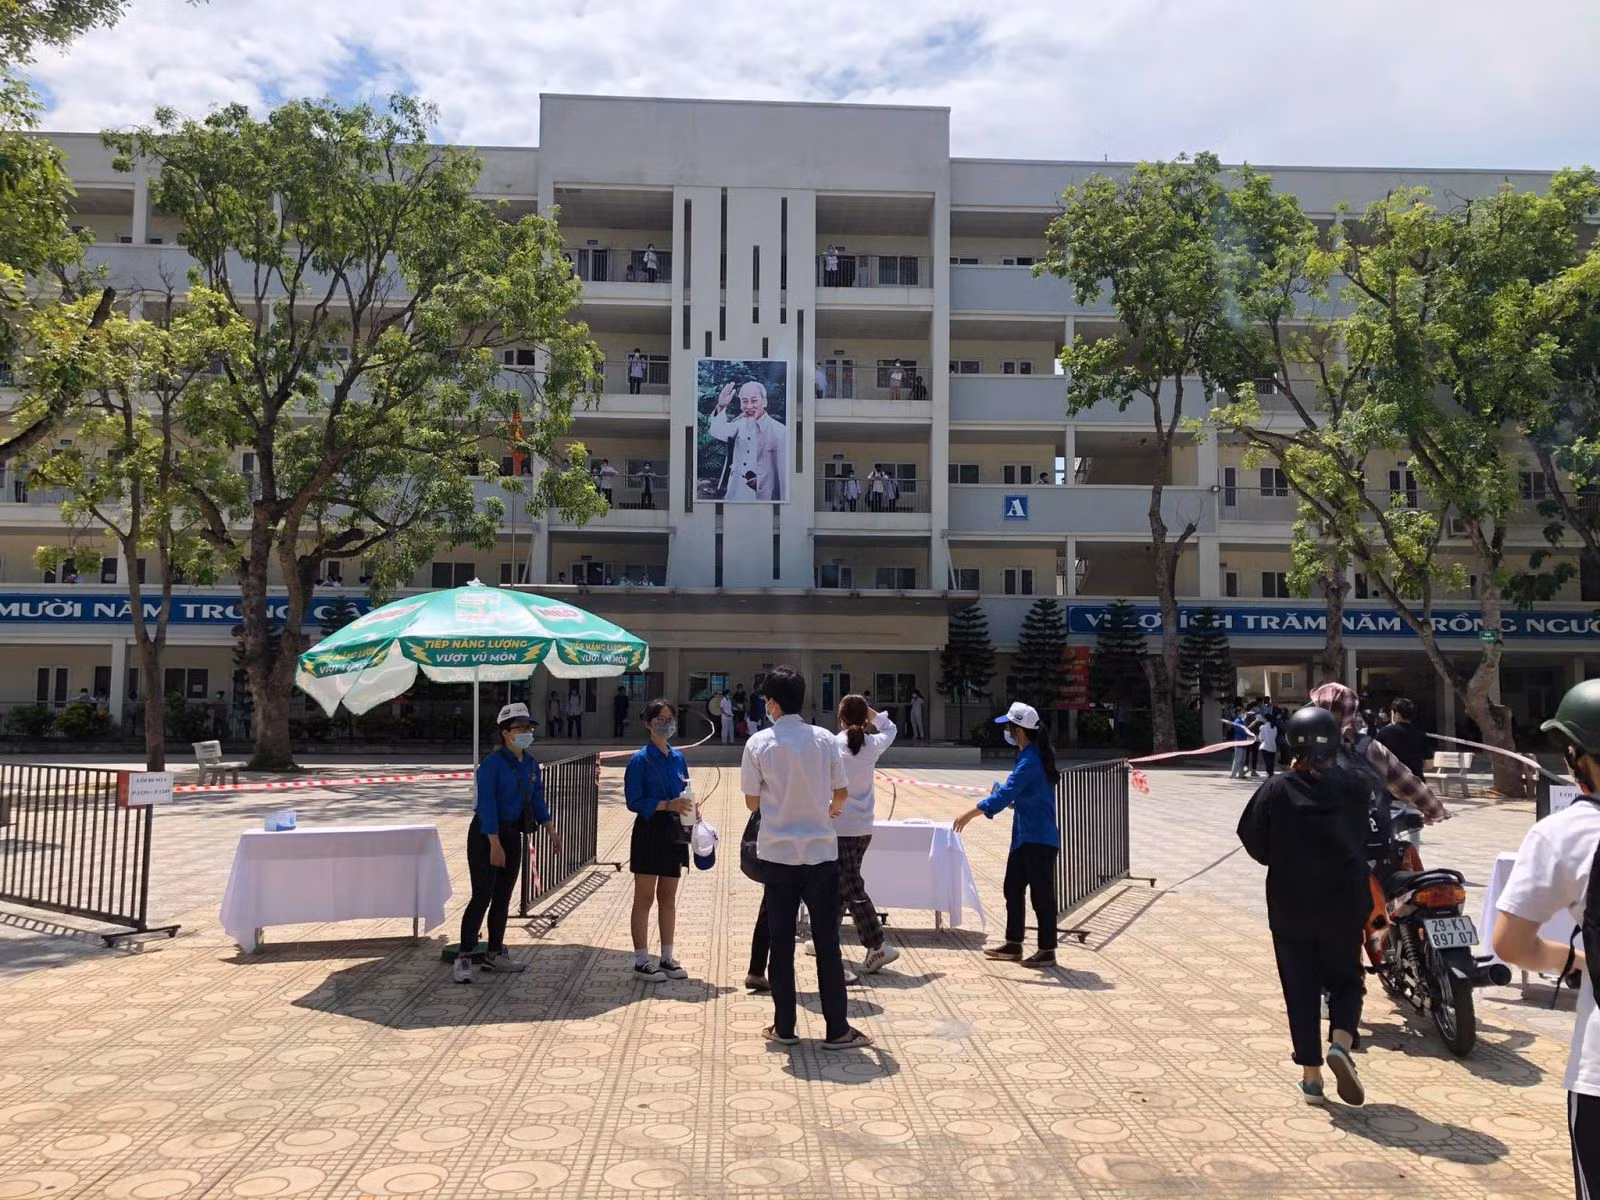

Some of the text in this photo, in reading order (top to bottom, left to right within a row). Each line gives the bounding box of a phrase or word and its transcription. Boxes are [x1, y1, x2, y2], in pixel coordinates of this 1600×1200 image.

[1006, 498, 1026, 517] A
[0, 598, 82, 618] MƯỜI
[181, 603, 290, 620] TRG
[1241, 612, 1327, 630] TRĂM
[1342, 613, 1401, 631] NĂM
[1417, 611, 1517, 632] RỒG
[424, 639, 450, 649] TIẾP
[488, 639, 528, 651] LƯỢNG
[435, 652, 468, 664] VƯỢT
[490, 651, 517, 662] MÔN
[1431, 918, 1468, 933] 29-K1
[1432, 932, 1474, 947] 897.07
